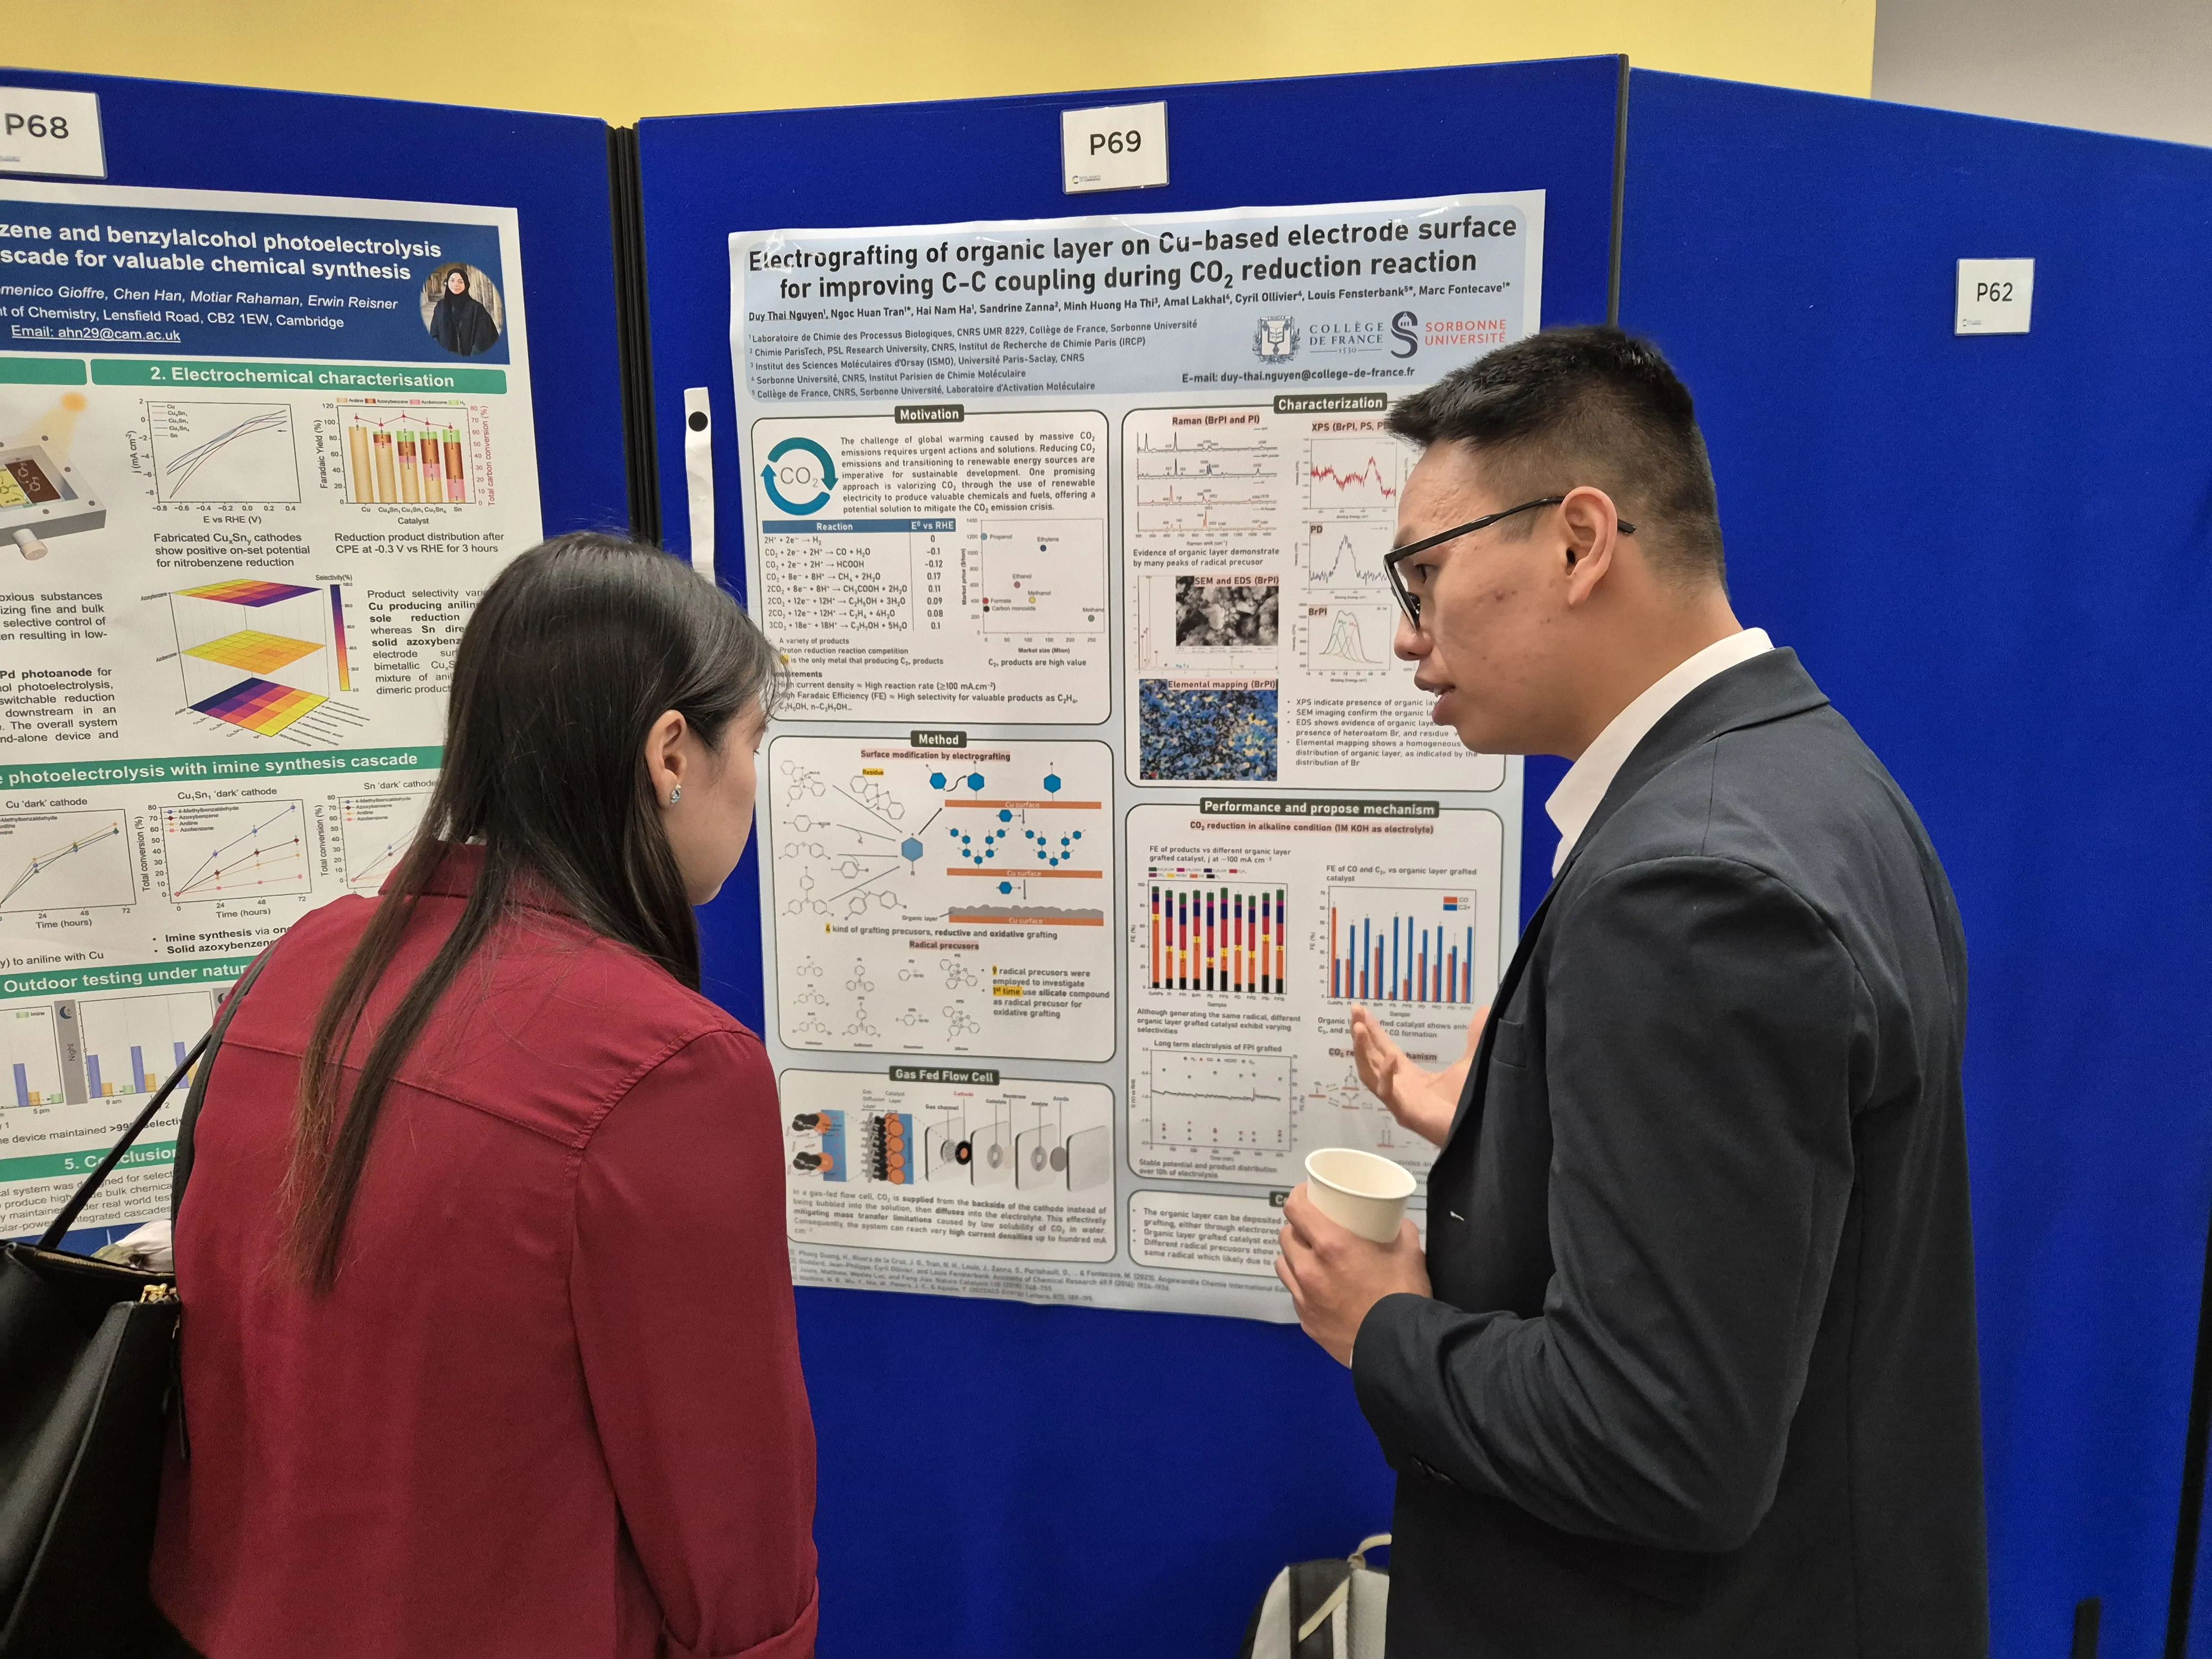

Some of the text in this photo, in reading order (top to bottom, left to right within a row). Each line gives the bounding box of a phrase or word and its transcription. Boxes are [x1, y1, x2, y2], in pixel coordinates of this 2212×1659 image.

[5, 113, 69, 139] P68
[1090, 130, 1141, 155] P69
[59, 225, 100, 241] and
[107, 226, 256, 248] benzylalcohol
[263, 233, 441, 259] photoelectrolysis
[749, 215, 1516, 272] Electrografting of organic layer on Cu-based electrode surface
[75, 249, 107, 267] for
[112, 252, 204, 270] valuable
[211, 255, 305, 274] chemical
[312, 261, 410, 280] synthesis
[780, 278, 811, 299] for
[820, 273, 933, 301] improving
[942, 270, 985, 293] C-C
[995, 268, 1095, 294] coupling
[1104, 264, 1180, 288] during
[1242, 254, 1360, 280] reduction
[1371, 249, 1475, 274] reaction
[58, 286, 107, 300] Gioffre,
[113, 288, 149, 300] Chen
[154, 289, 184, 302] Han,
[190, 290, 232, 302] Motiar
[236, 291, 302, 307] Rahaman,
[308, 295, 343, 307] Erwin
[348, 296, 398, 309] Reisner
[1977, 282, 2012, 301] P62
[11, 305, 24, 316] of
[28, 306, 99, 322] Chemistry,
[103, 309, 161, 321] Lensfield
[165, 311, 203, 324] Road,
[207, 312, 234, 324] CB2
[239, 313, 272, 326] 1EW,
[276, 314, 343, 329] Cambridge
[1310, 321, 1383, 333] COLLÈGE
[1425, 319, 1506, 332] SORBONNE
[12, 325, 181, 341] Email: ahn29@cam.ac.uk
[1310, 334, 1382, 345] DE FRANCE
[1425, 332, 1505, 345] UNIVERSITÉ
[150, 366, 453, 387] 2. Electrochemical characterisation
[797, 373, 839, 383] Université,
[842, 373, 867, 383] CNRS,
[900, 372, 932, 380] Parisien
[947, 371, 975, 379] Chimie
[978, 369, 1025, 378] Moléculaire
[1279, 397, 1382, 410] Characterization
[900, 408, 958, 420] Motivation
[1229, 415, 1245, 423] and
[860, 436, 898, 446] challenge
[918, 435, 942, 445] global
[948, 434, 983, 444] warming
[989, 433, 1019, 441] caused
[1024, 433, 1034, 442] by
[816, 522, 852, 530] Reaction
[153, 533, 210, 542] Fabricated
[254, 533, 301, 541] cathodes
[334, 532, 504, 542] Reduction product distribution after
[155, 545, 310, 556] show positive on-set potential
[1209, 548, 1228, 557] layer
[1194, 576, 1213, 585] SEM
[1168, 680, 1210, 690] Elemental
[1212, 681, 1248, 690] mapping
[919, 734, 958, 744] Method
[941, 752, 950, 760] by
[952, 752, 1010, 761] electrografting
[9, 753, 417, 786] photoelectrolysis with imine synthesis cascade
[49, 797, 87, 806] cathode
[1204, 801, 1433, 815] Performance and propose mechanism
[1384, 825, 1433, 834] electrolyte)
[60, 919, 92, 928] (hours)
[4, 967, 197, 992] Outdoor testing under
[896, 1068, 993, 1082] Gas Fed Flow Cell
[1143, 1207, 1157, 1215] The
[1191, 1211, 1211, 1220] layer
[1242, 1215, 1280, 1224] deposited
